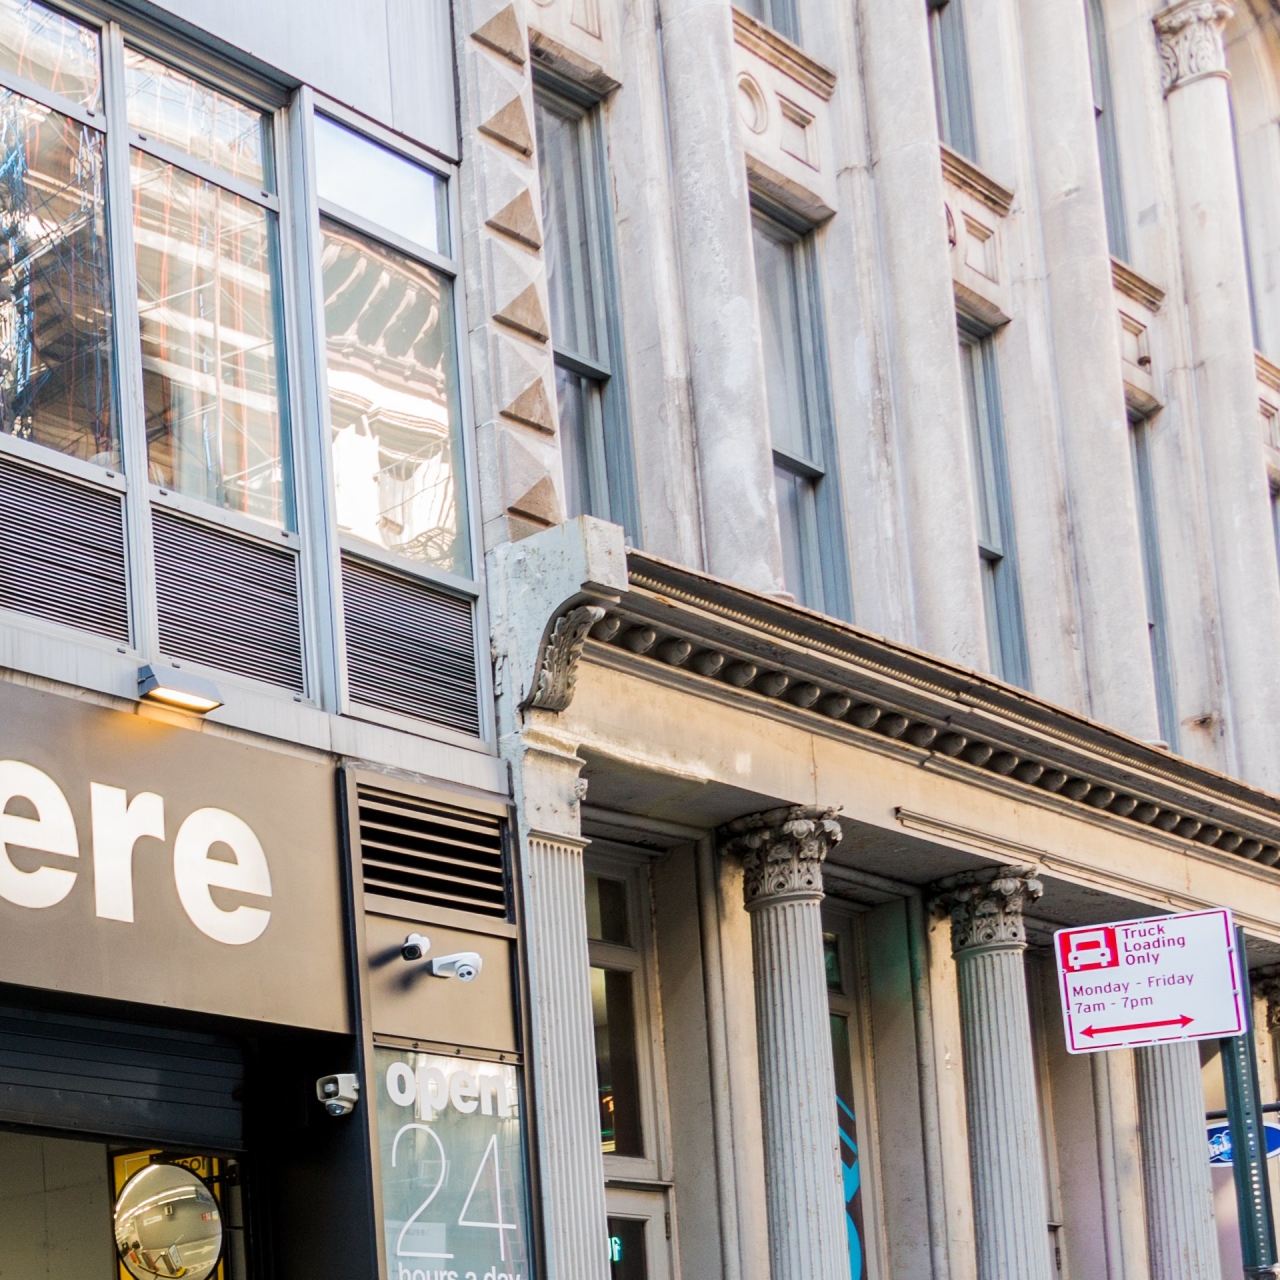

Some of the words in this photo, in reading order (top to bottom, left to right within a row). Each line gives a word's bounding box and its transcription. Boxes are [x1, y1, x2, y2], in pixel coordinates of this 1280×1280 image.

[1122, 924, 1165, 940] Truck
[1124, 935, 1186, 953] Loading
[1125, 953, 1160, 966] Only
[1072, 980, 1130, 998] Monday
[1147, 973, 1194, 989] Friday
[1075, 1002, 1106, 1014] 7am
[1121, 995, 1154, 1010] 7pm
[386, 1061, 511, 1122] open
[392, 1123, 517, 1262] 24
